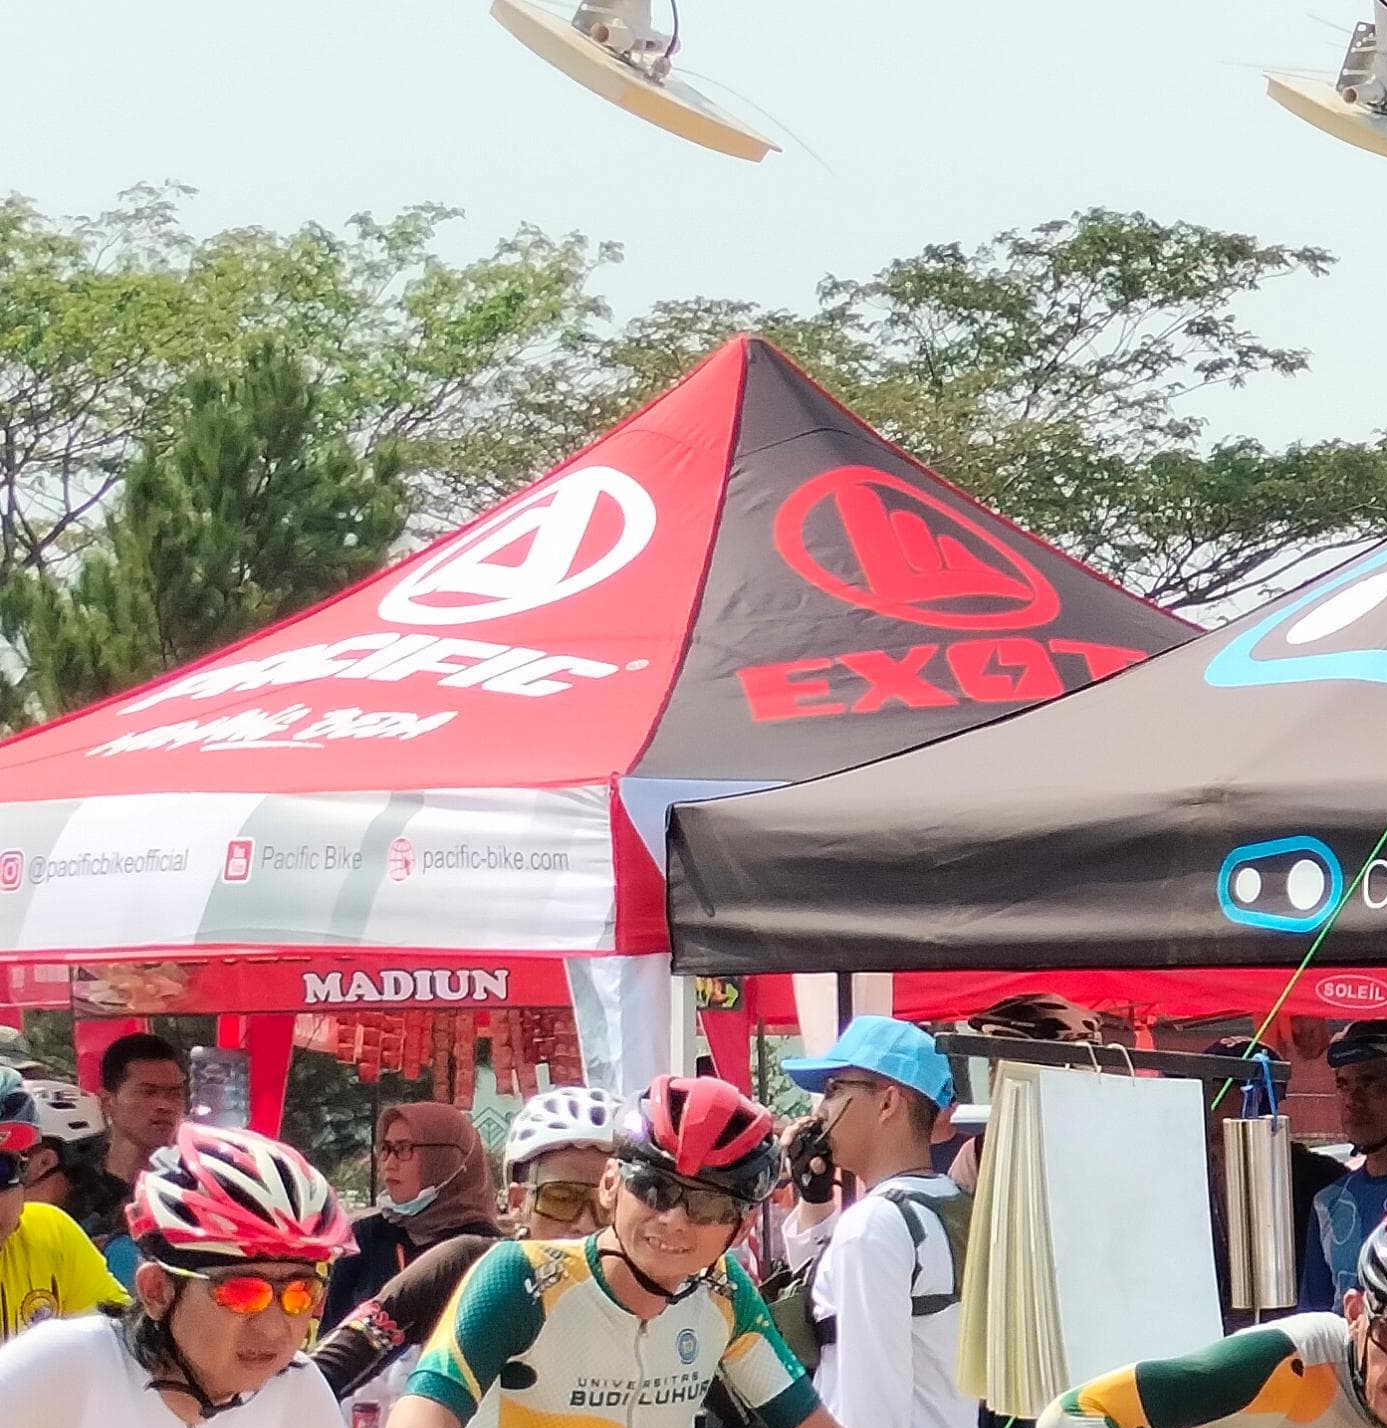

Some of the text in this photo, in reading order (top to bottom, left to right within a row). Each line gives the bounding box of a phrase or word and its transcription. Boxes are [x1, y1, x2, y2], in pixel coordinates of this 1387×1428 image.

[735, 638, 1149, 723] EXOT
[28, 848, 190, 885] @pacificbikeofficial
[261, 845, 362, 872] Pacific Bike
[422, 847, 570, 873] pacific-bike.com
[303, 967, 510, 1004] MADIUN
[577, 1370, 699, 1391] UNIVERSITAS
[569, 1386, 630, 1408] BUDI
